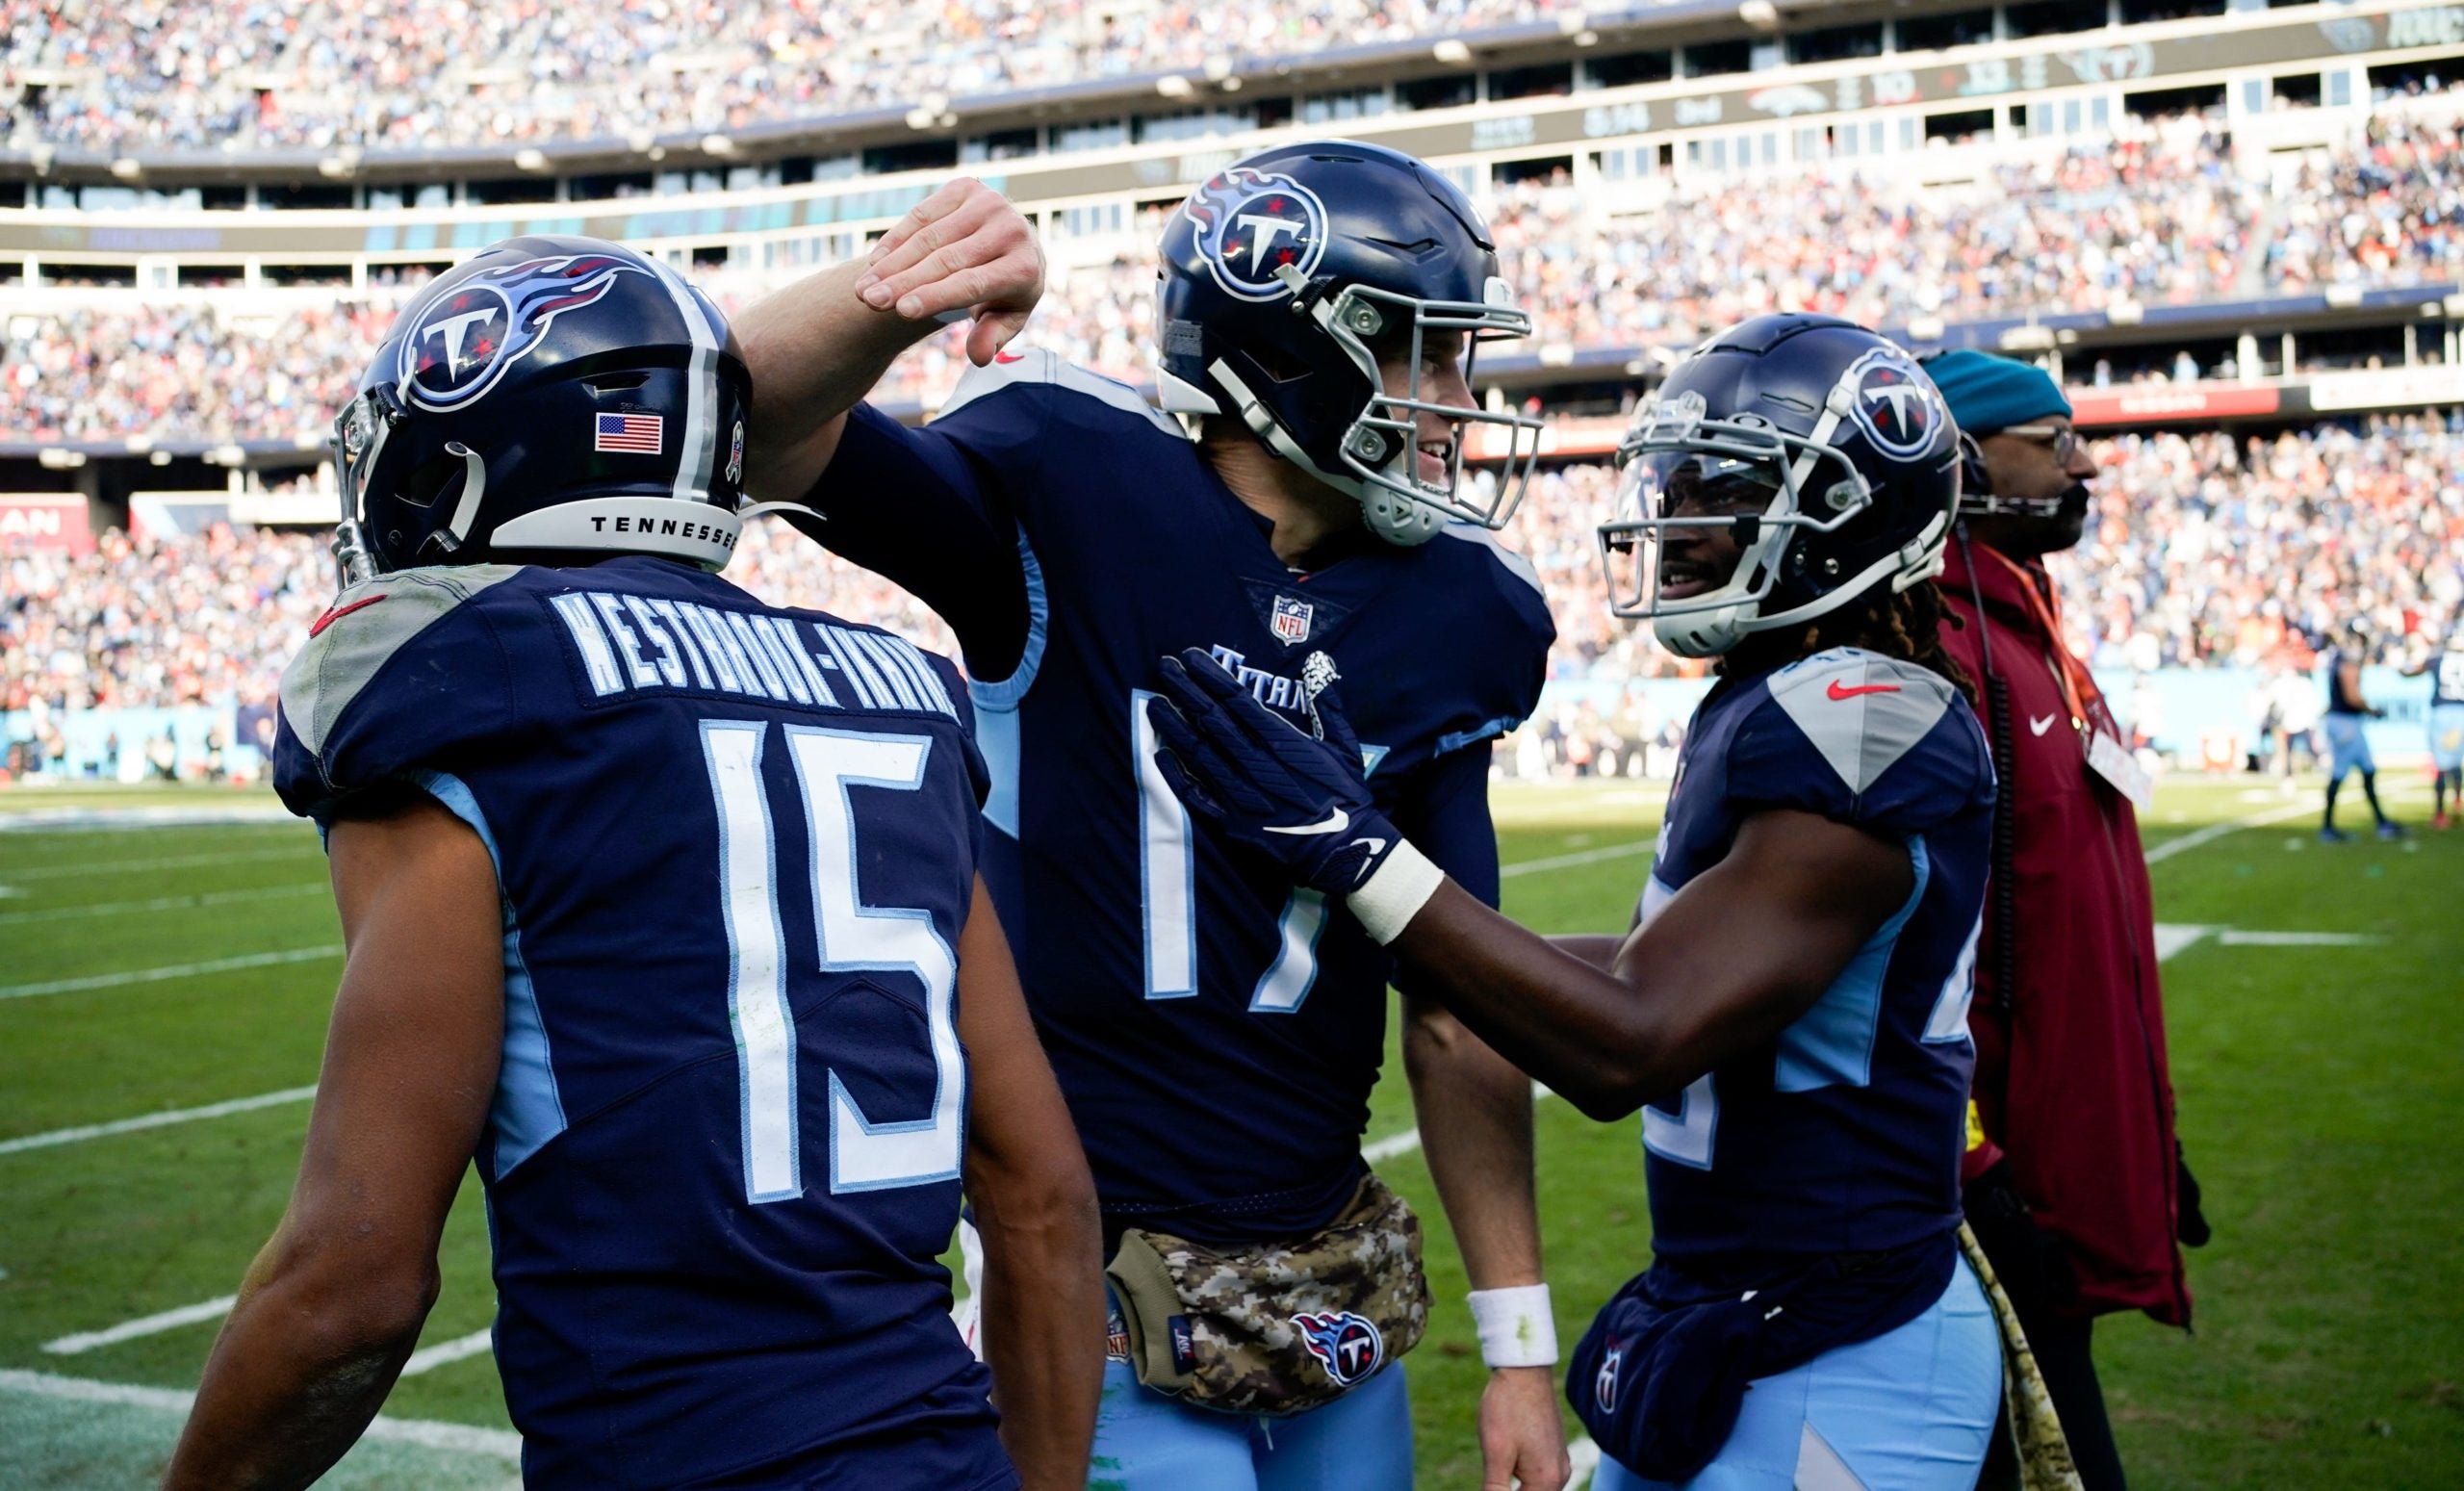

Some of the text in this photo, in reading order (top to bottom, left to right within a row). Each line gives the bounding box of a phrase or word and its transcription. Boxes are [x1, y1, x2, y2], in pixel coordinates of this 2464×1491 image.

[1237, 215, 1304, 277] T
[423, 307, 498, 383] T
[1863, 385, 1917, 440] T
[1278, 615, 1302, 636] NFL
[549, 592, 962, 726] WESTBROOK-IKHIN
[698, 719, 962, 1204] 15
[1339, 1337, 1370, 1373] T
